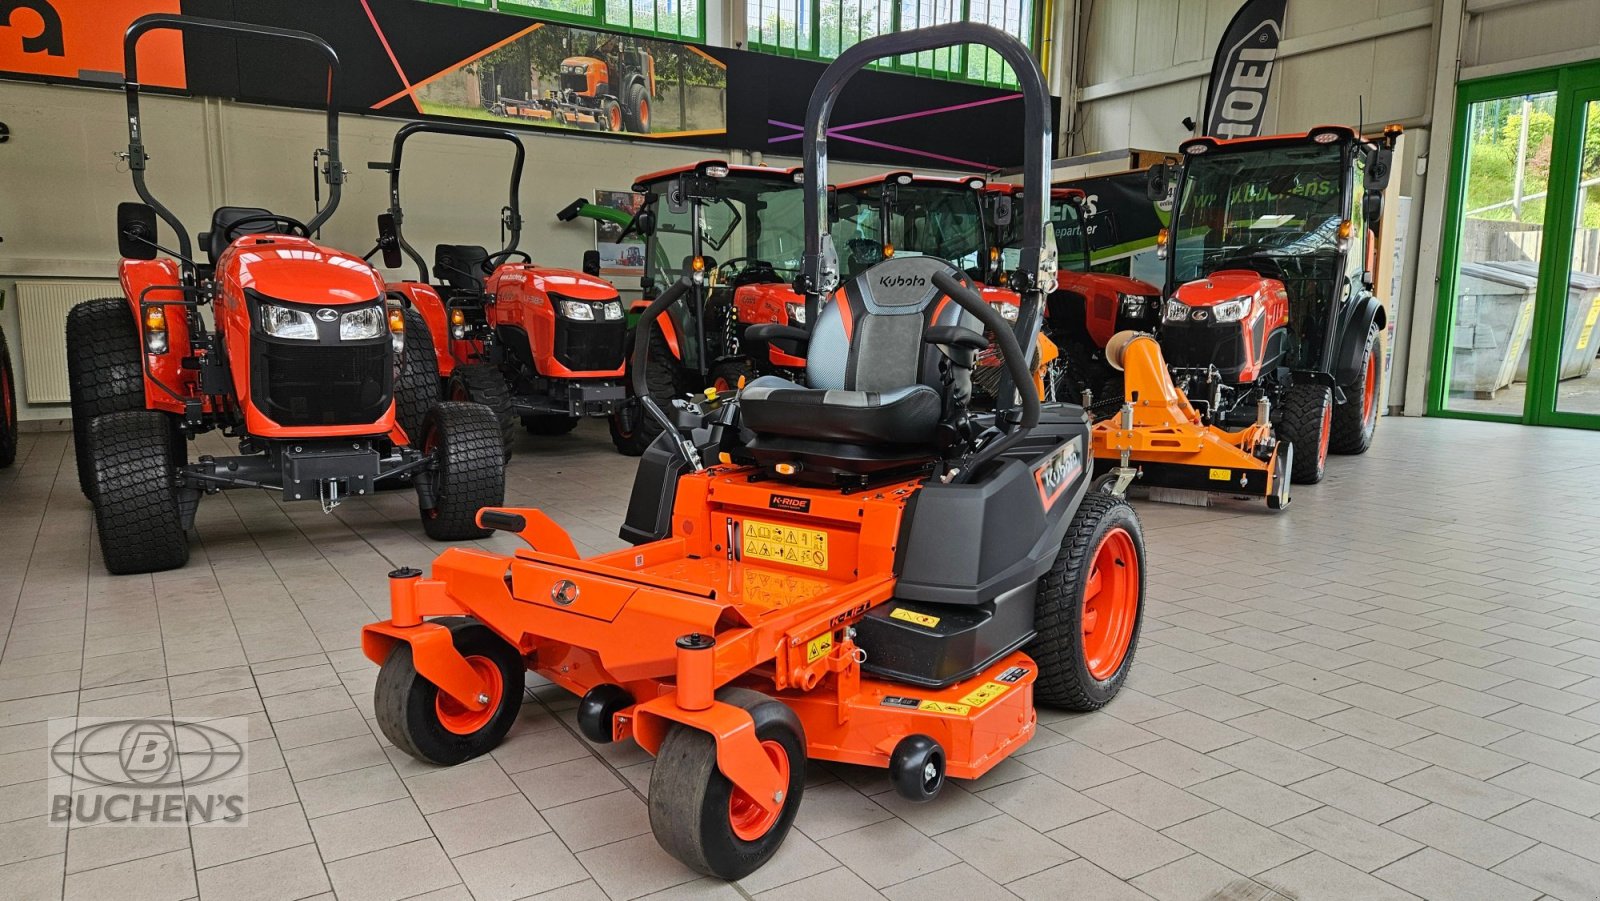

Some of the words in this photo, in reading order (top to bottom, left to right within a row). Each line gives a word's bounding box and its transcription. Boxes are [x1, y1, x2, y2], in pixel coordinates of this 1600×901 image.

[880, 275, 925, 287] Kubota
[1044, 452, 1078, 488] Kubota
[772, 496, 808, 508] K-RIDE
